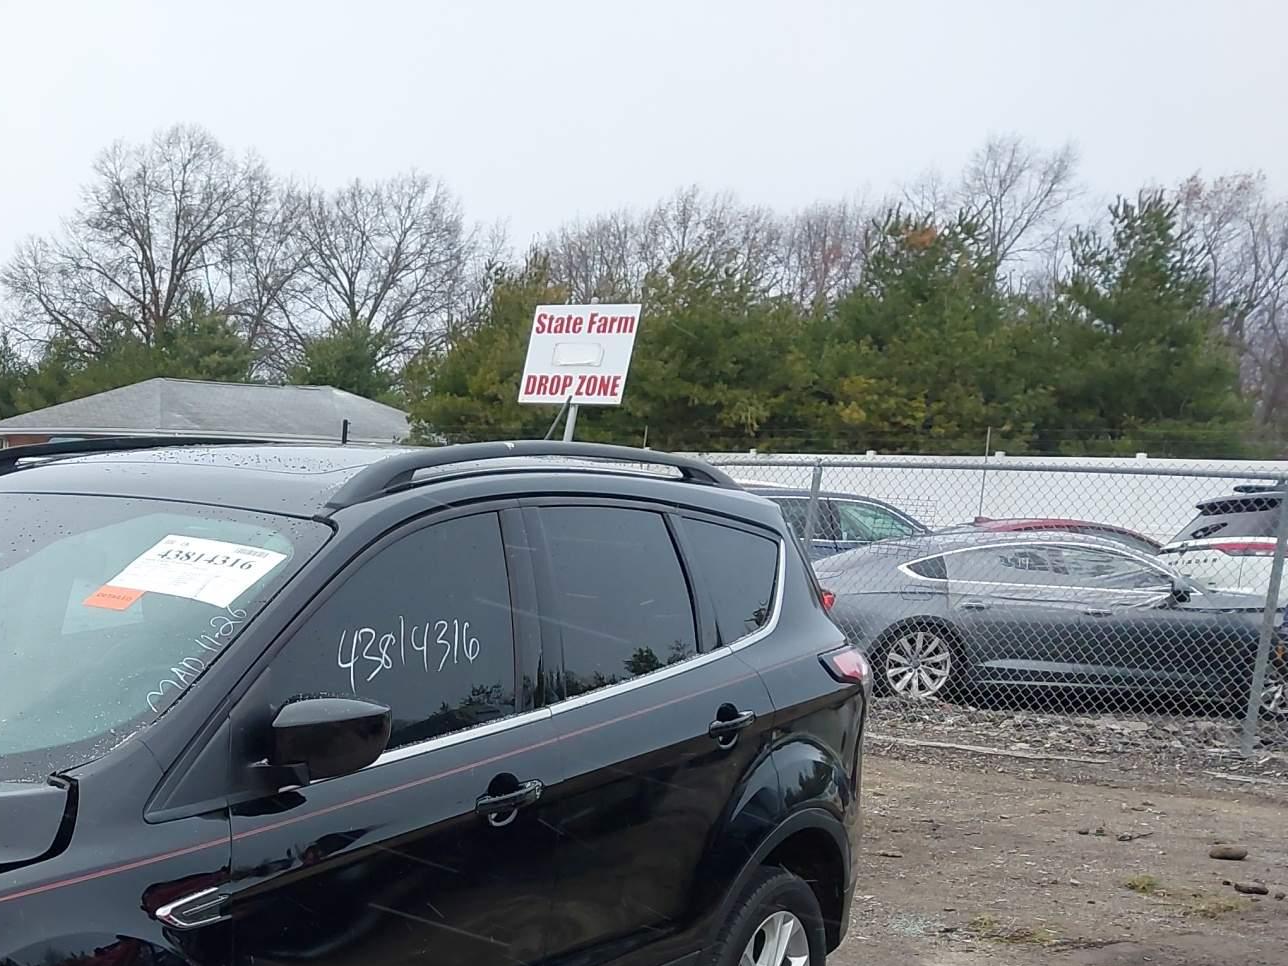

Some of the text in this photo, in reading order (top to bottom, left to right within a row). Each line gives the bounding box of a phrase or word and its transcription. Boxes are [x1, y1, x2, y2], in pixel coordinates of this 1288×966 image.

[535, 312, 636, 335] State Farm
[523, 374, 622, 397] DROP ZONE
[157, 548, 257, 571] 43814316
[337, 615, 480, 694] 43814316
